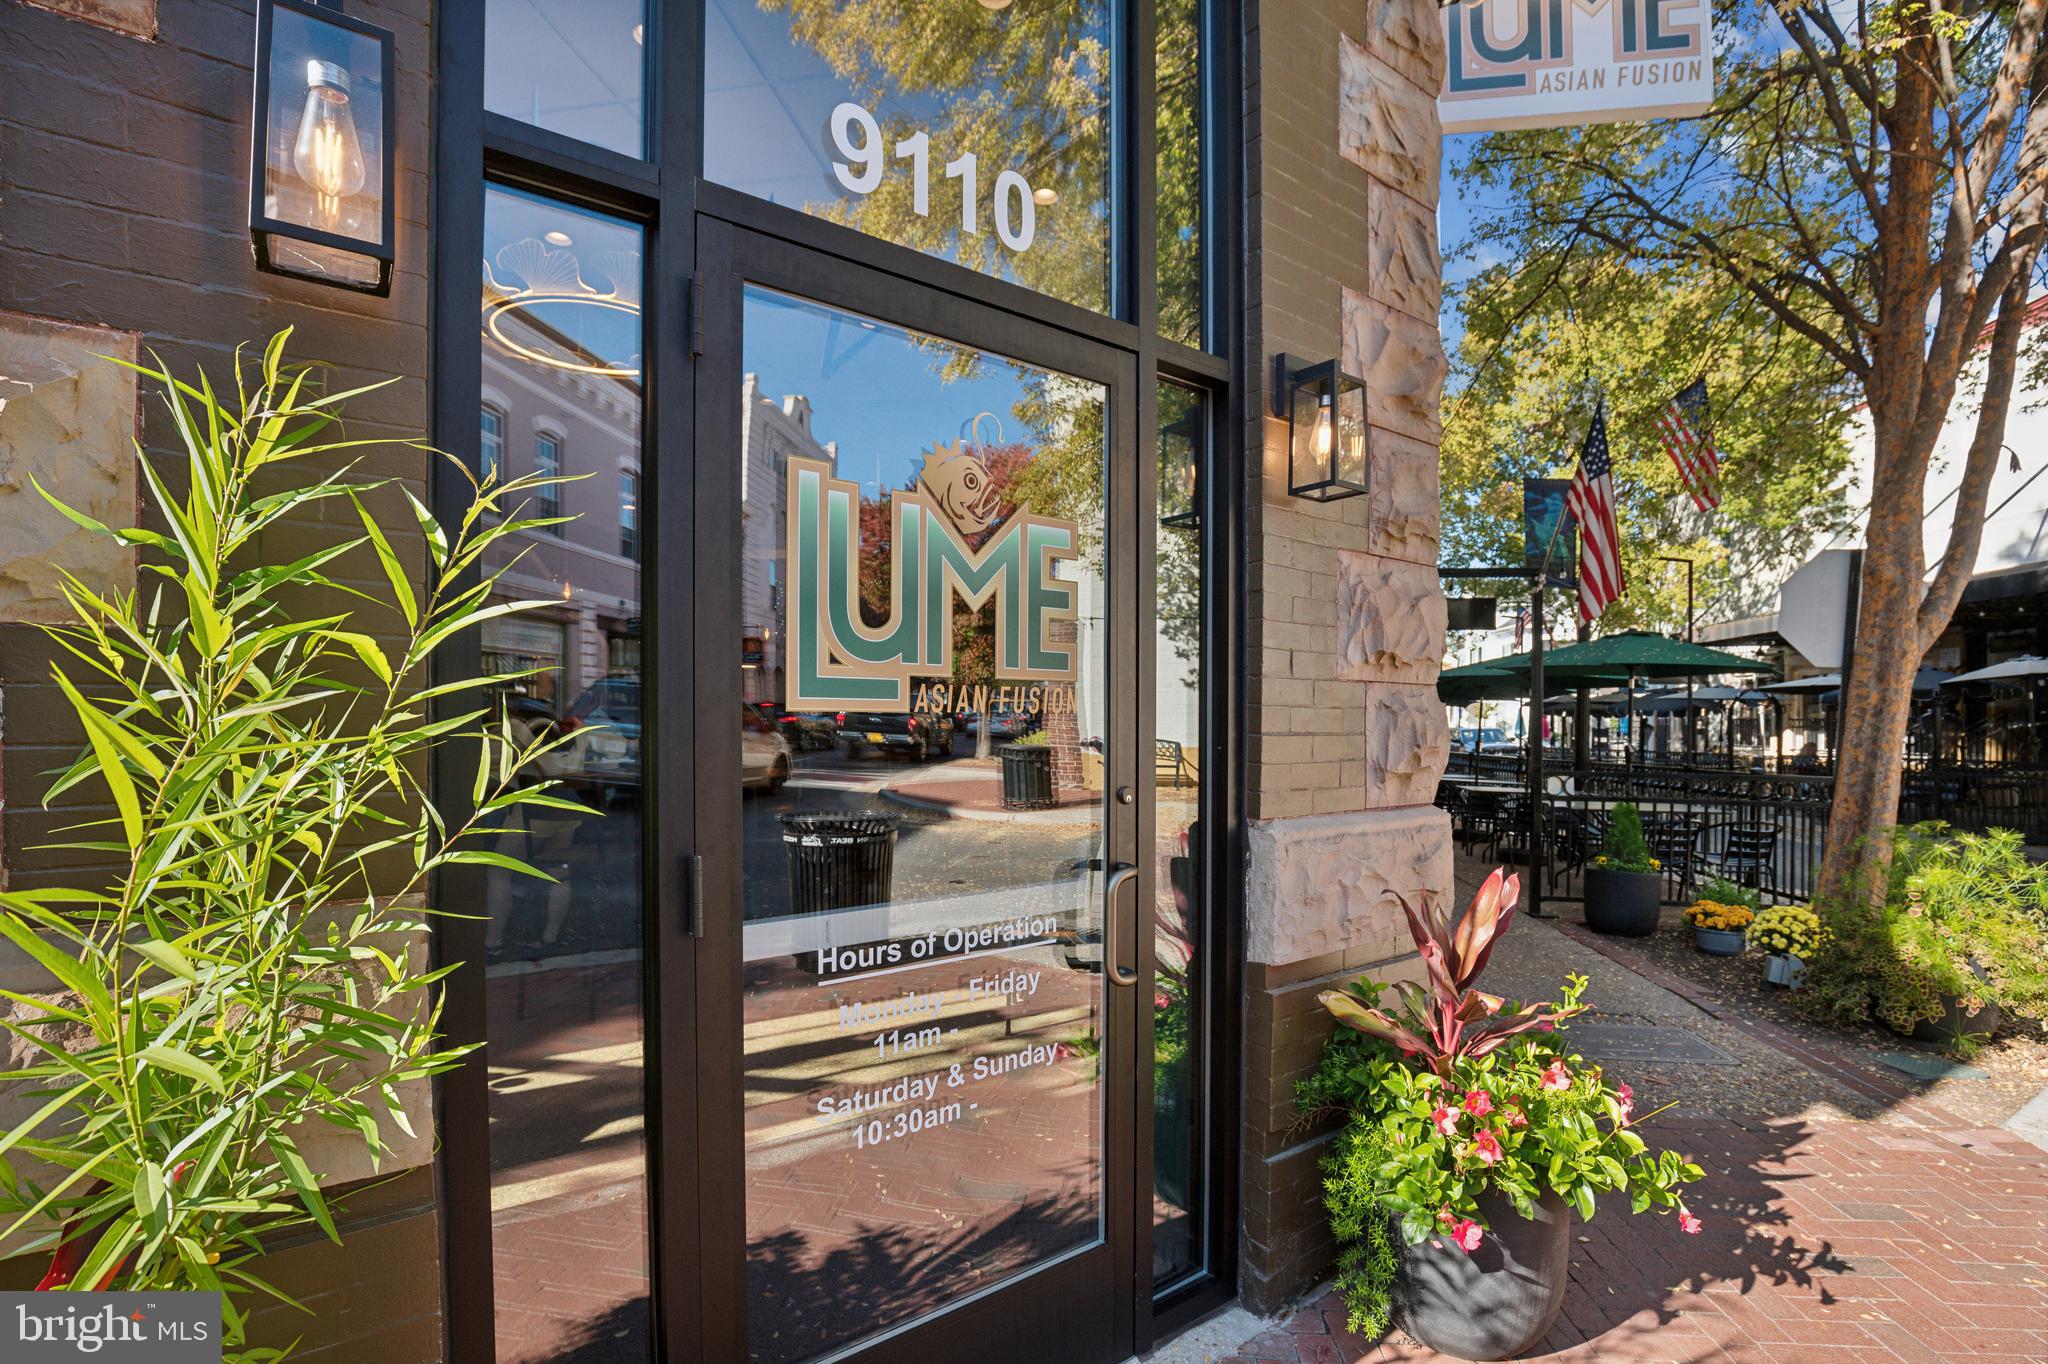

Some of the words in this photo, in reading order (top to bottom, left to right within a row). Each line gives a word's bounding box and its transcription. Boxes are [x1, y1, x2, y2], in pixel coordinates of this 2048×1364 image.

[1540, 68, 1606, 94] ASIAN
[1618, 60, 1702, 88] FUSION
[830, 102, 1036, 252] 9110
[786, 455, 1078, 713] LUME
[914, 684, 988, 714] ASIAN
[998, 685, 1077, 714] FUSION
[817, 940, 902, 975] Hours
[910, 930, 938, 958] of
[943, 914, 1058, 954] Operation
[838, 991, 944, 1031] Monday
[969, 971, 1041, 1003] Friday
[873, 1025, 941, 1058] 11am
[816, 1072, 939, 1124] Saturday
[947, 1062, 966, 1088] &
[973, 1042, 1059, 1080] Sunday
[852, 1100, 962, 1150] 10:30am
